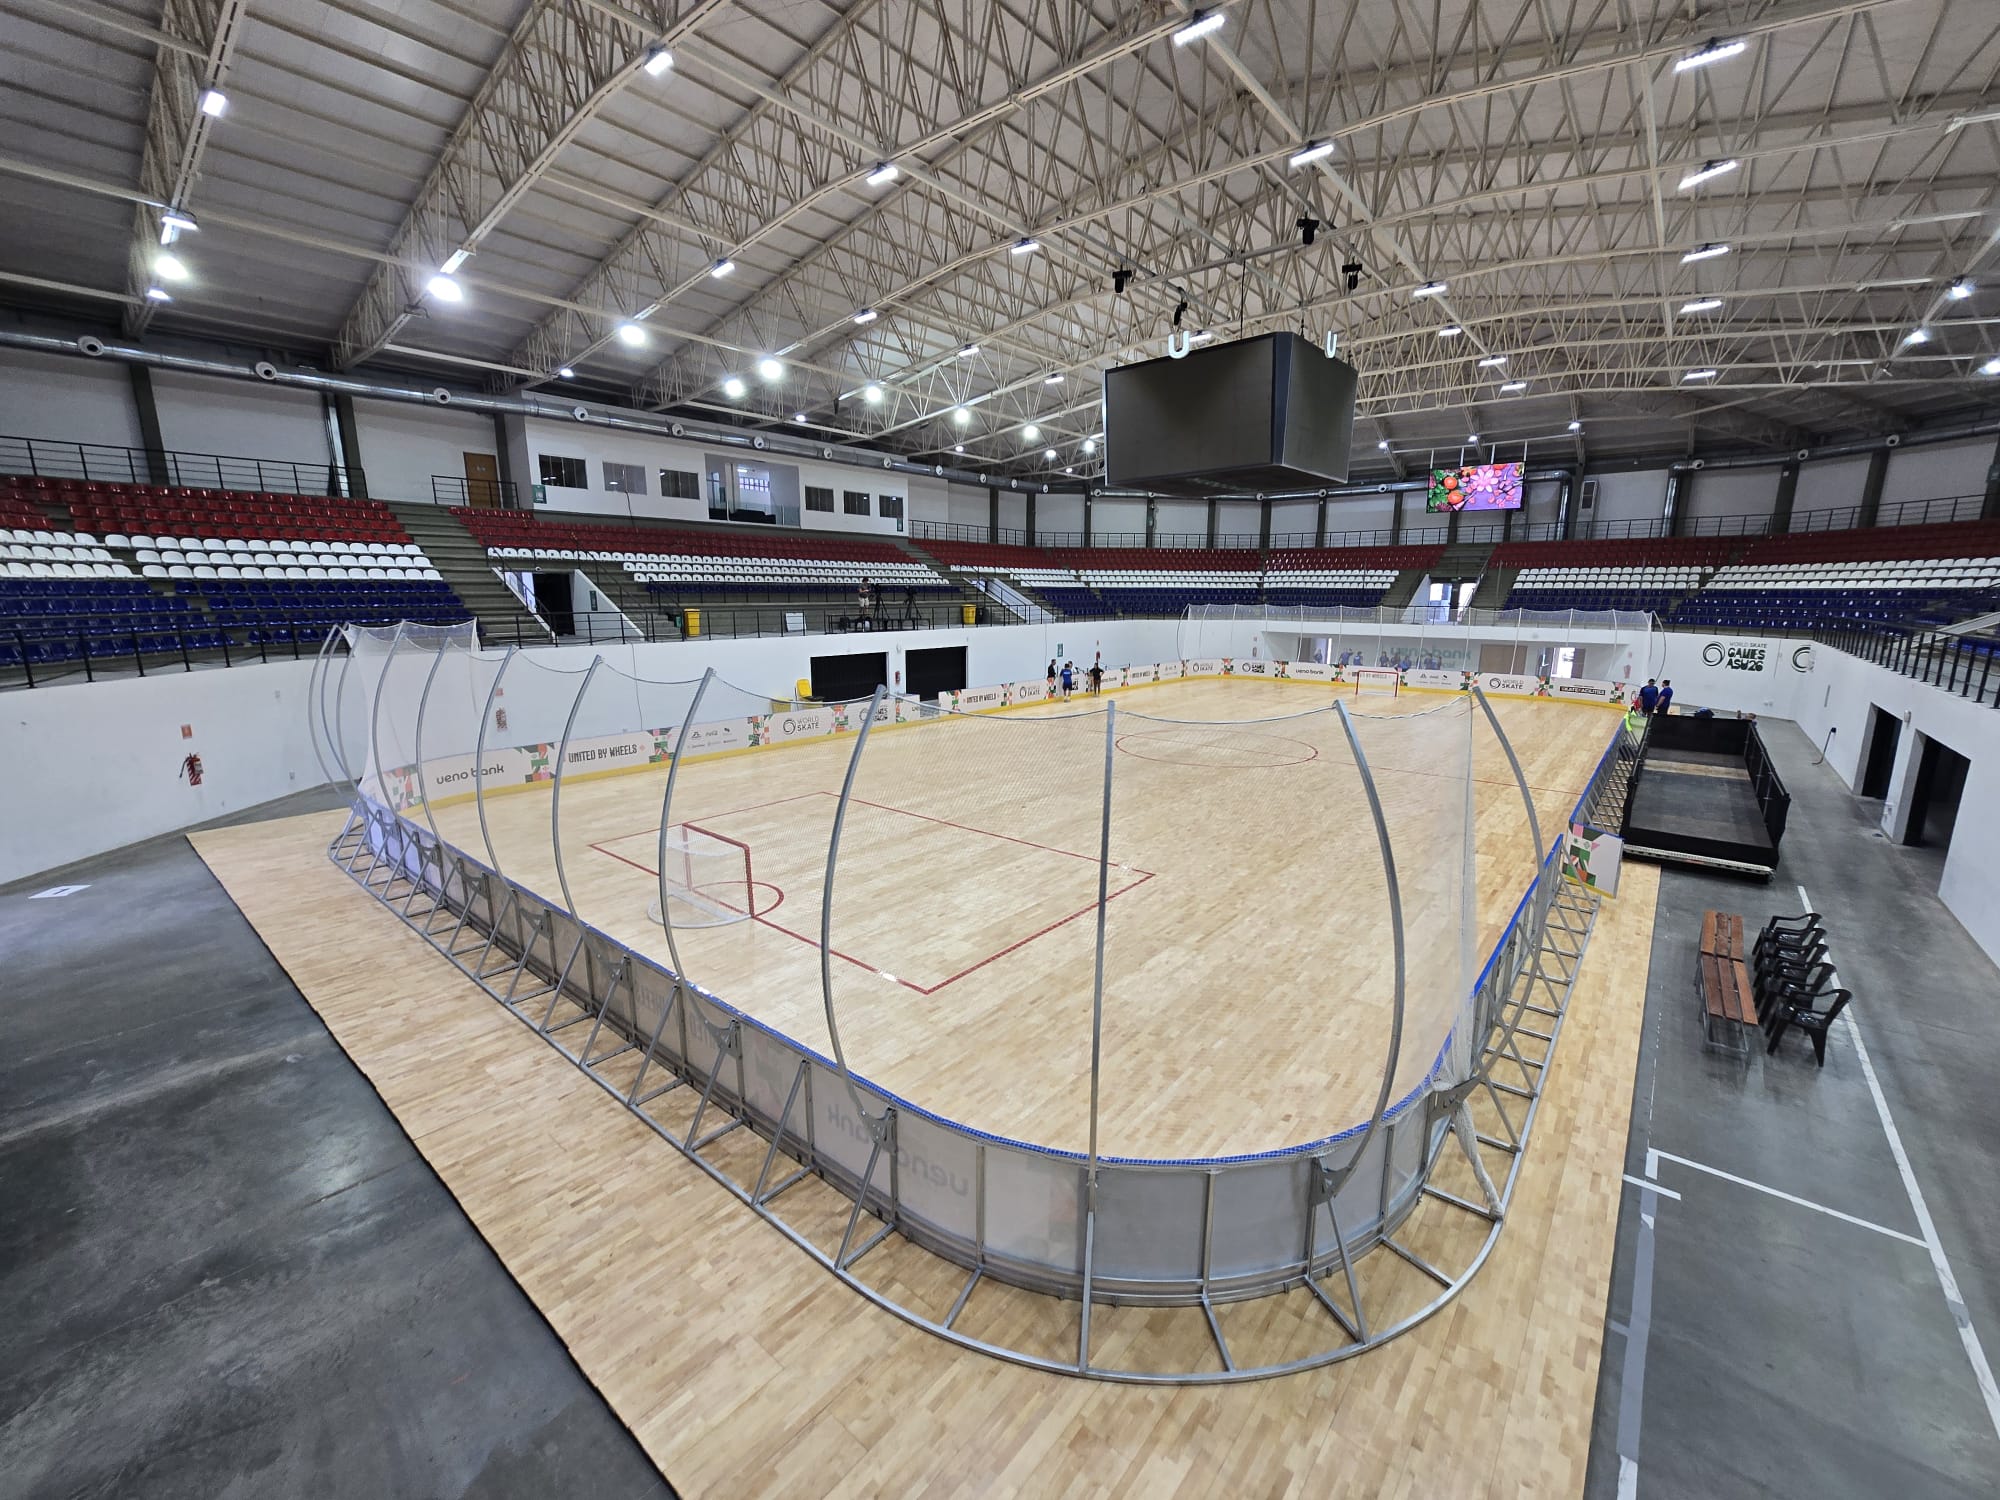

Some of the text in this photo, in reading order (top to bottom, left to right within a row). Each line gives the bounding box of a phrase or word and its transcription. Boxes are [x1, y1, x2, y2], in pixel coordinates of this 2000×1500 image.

[1728, 647, 1766, 660] GAMES
[1725, 658, 1764, 672] ASU26
[797, 721, 820, 732] SKATE
[568, 744, 638, 763] UNITED BY WHEELS
[436, 763, 505, 785] ueno bank
